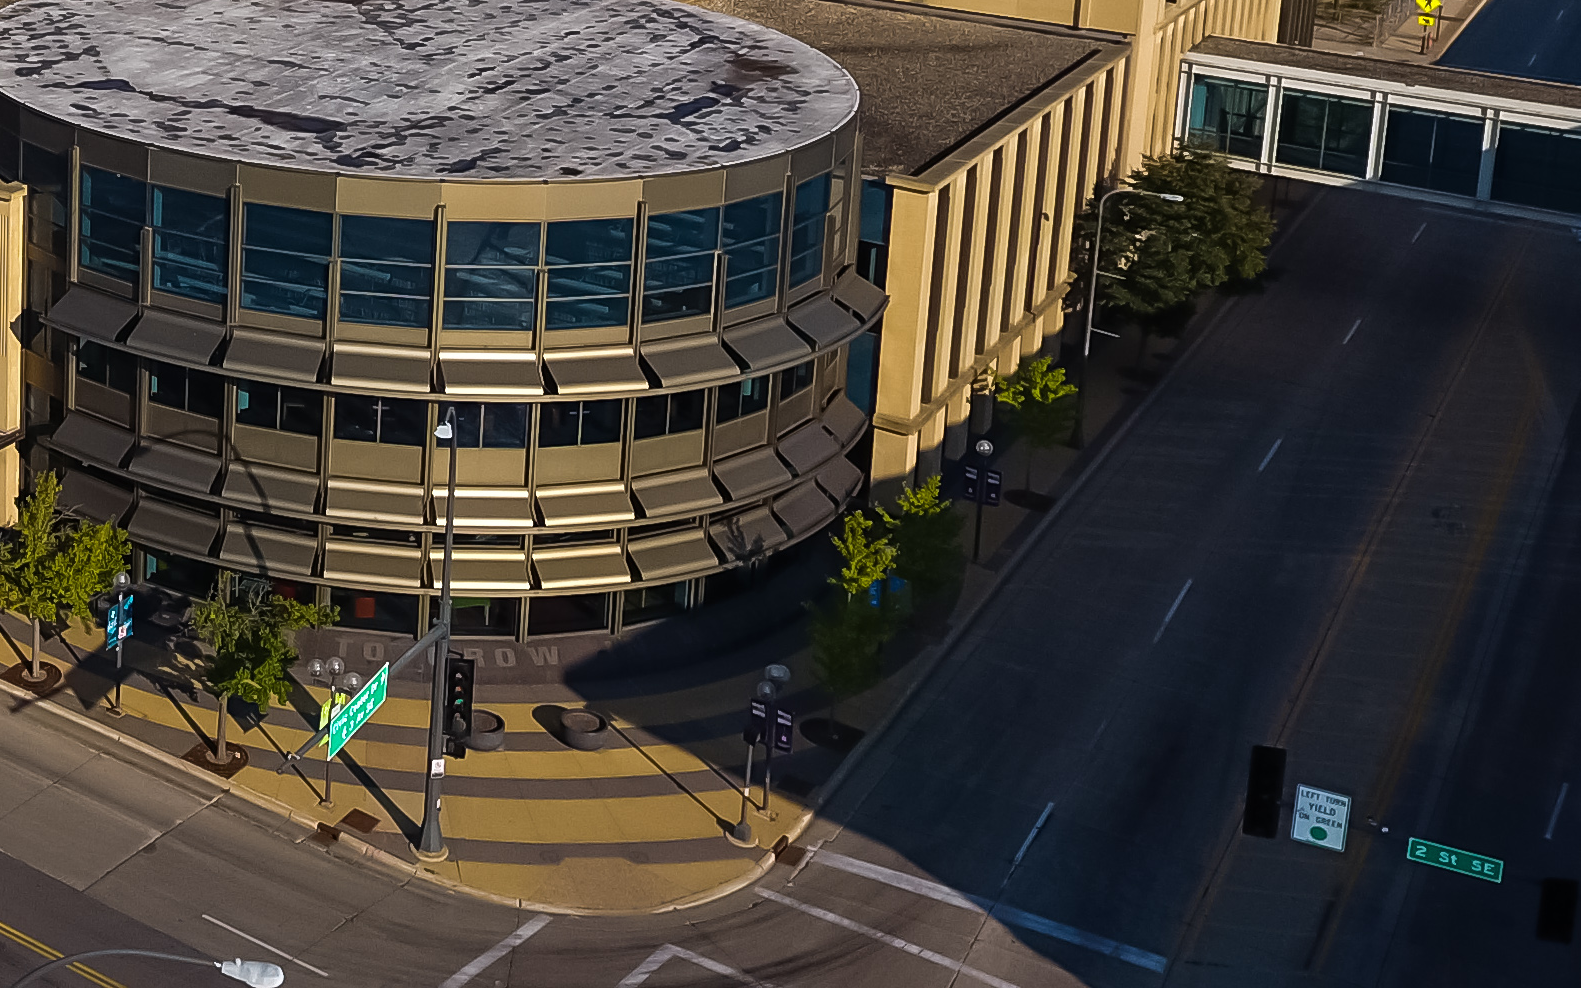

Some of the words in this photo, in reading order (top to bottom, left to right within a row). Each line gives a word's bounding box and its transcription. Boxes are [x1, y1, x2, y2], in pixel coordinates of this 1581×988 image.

[336, 638, 385, 661] TO
[1300, 789, 1321, 801] LEFT
[1325, 796, 1347, 808] TURN
[1308, 802, 1337, 817] YIELD
[1298, 811, 1310, 821] ON
[1315, 816, 1343, 830] GREEN
[1415, 845, 1427, 858] 2
[1438, 851, 1458, 866] St
[1471, 859, 1495, 876] SE
